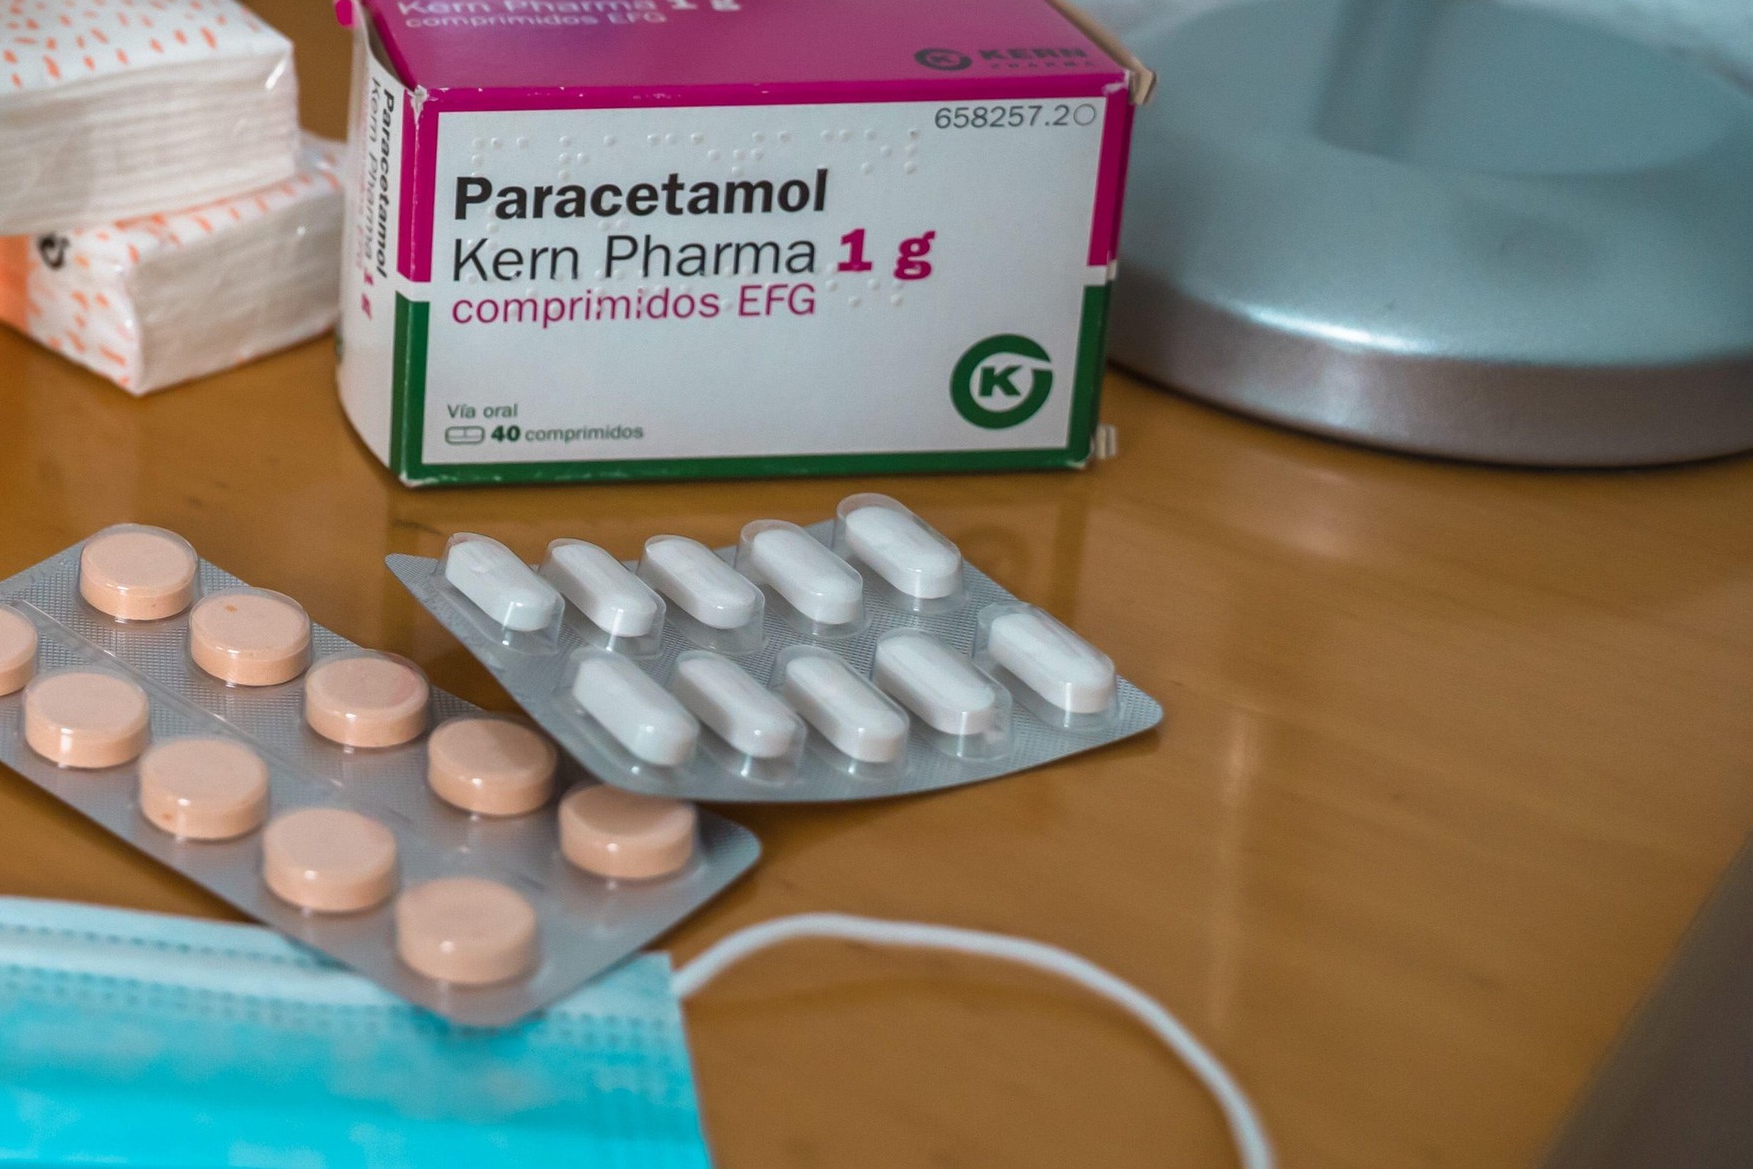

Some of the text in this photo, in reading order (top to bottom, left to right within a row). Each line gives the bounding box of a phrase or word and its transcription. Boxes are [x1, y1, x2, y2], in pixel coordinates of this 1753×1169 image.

[398, 0, 491, 15] Kern
[405, 12, 599, 28] comprimidos
[376, 88, 395, 279] Paracetamol
[454, 168, 829, 220] Paracetamol
[452, 227, 937, 282] Kern Pharma 1 g
[451, 282, 817, 330] comprimidos EFG
[482, 403, 519, 419] oral
[490, 424, 645, 444] 40 comprimidos
